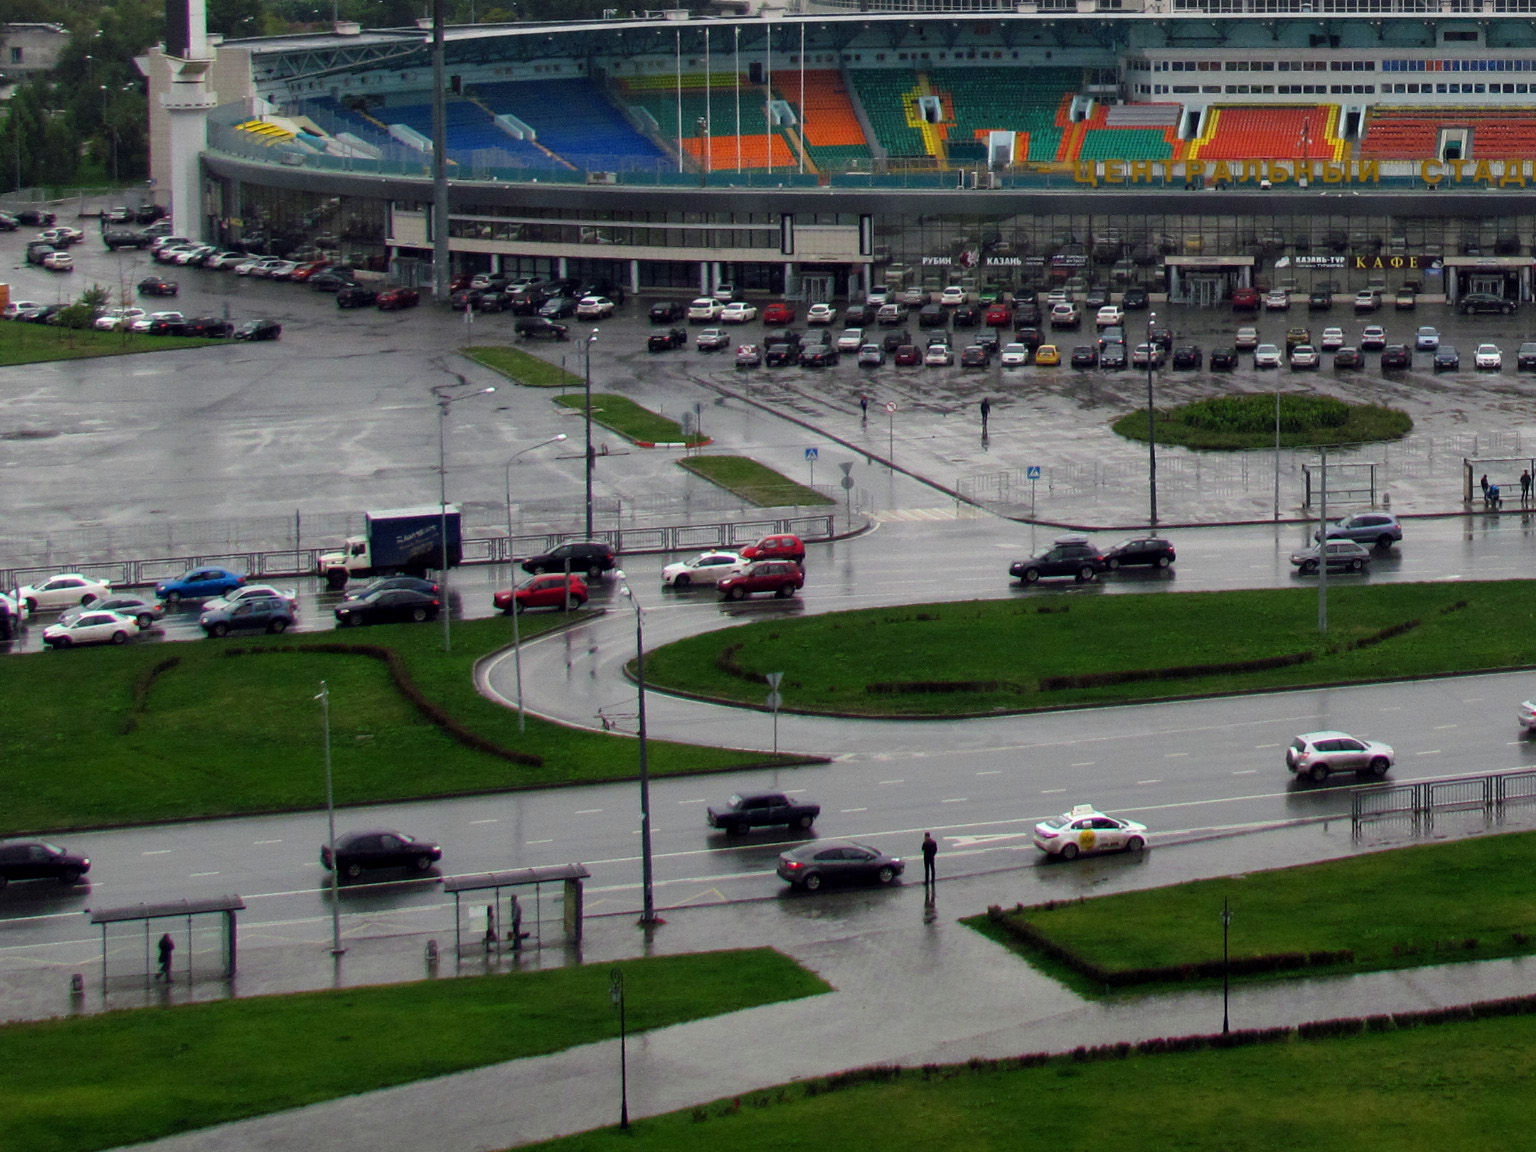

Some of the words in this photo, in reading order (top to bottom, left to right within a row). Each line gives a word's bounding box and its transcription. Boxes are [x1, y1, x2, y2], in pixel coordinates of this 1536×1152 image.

[922, 257, 952, 265] РУБИН
[986, 257, 1022, 266] КАЗАНЬ
[1356, 256, 1419, 269] КАФЕ
